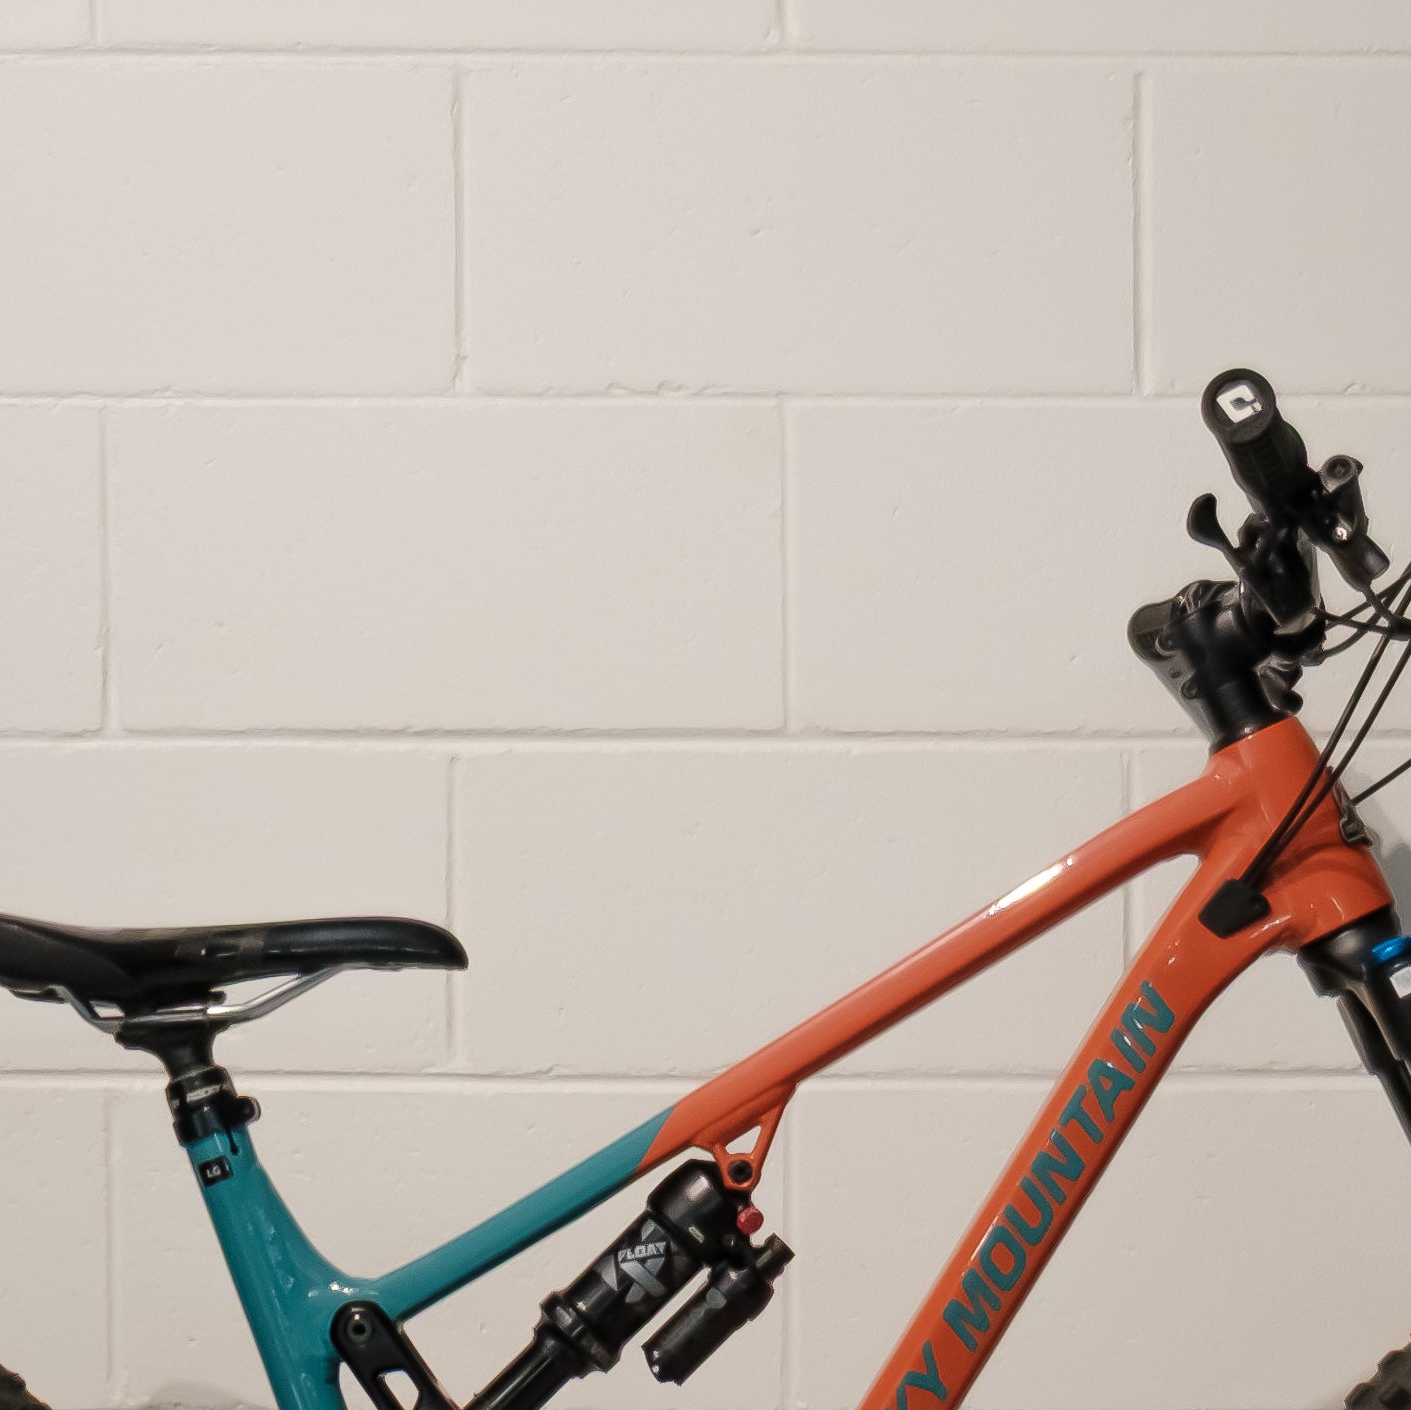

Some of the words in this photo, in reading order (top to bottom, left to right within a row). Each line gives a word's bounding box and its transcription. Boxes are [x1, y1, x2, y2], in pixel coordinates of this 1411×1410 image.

[206, 1164, 222, 1178] LG
[943, 981, 1178, 1351] MOUNTAIN
[617, 1241, 667, 1262] FLOAT
